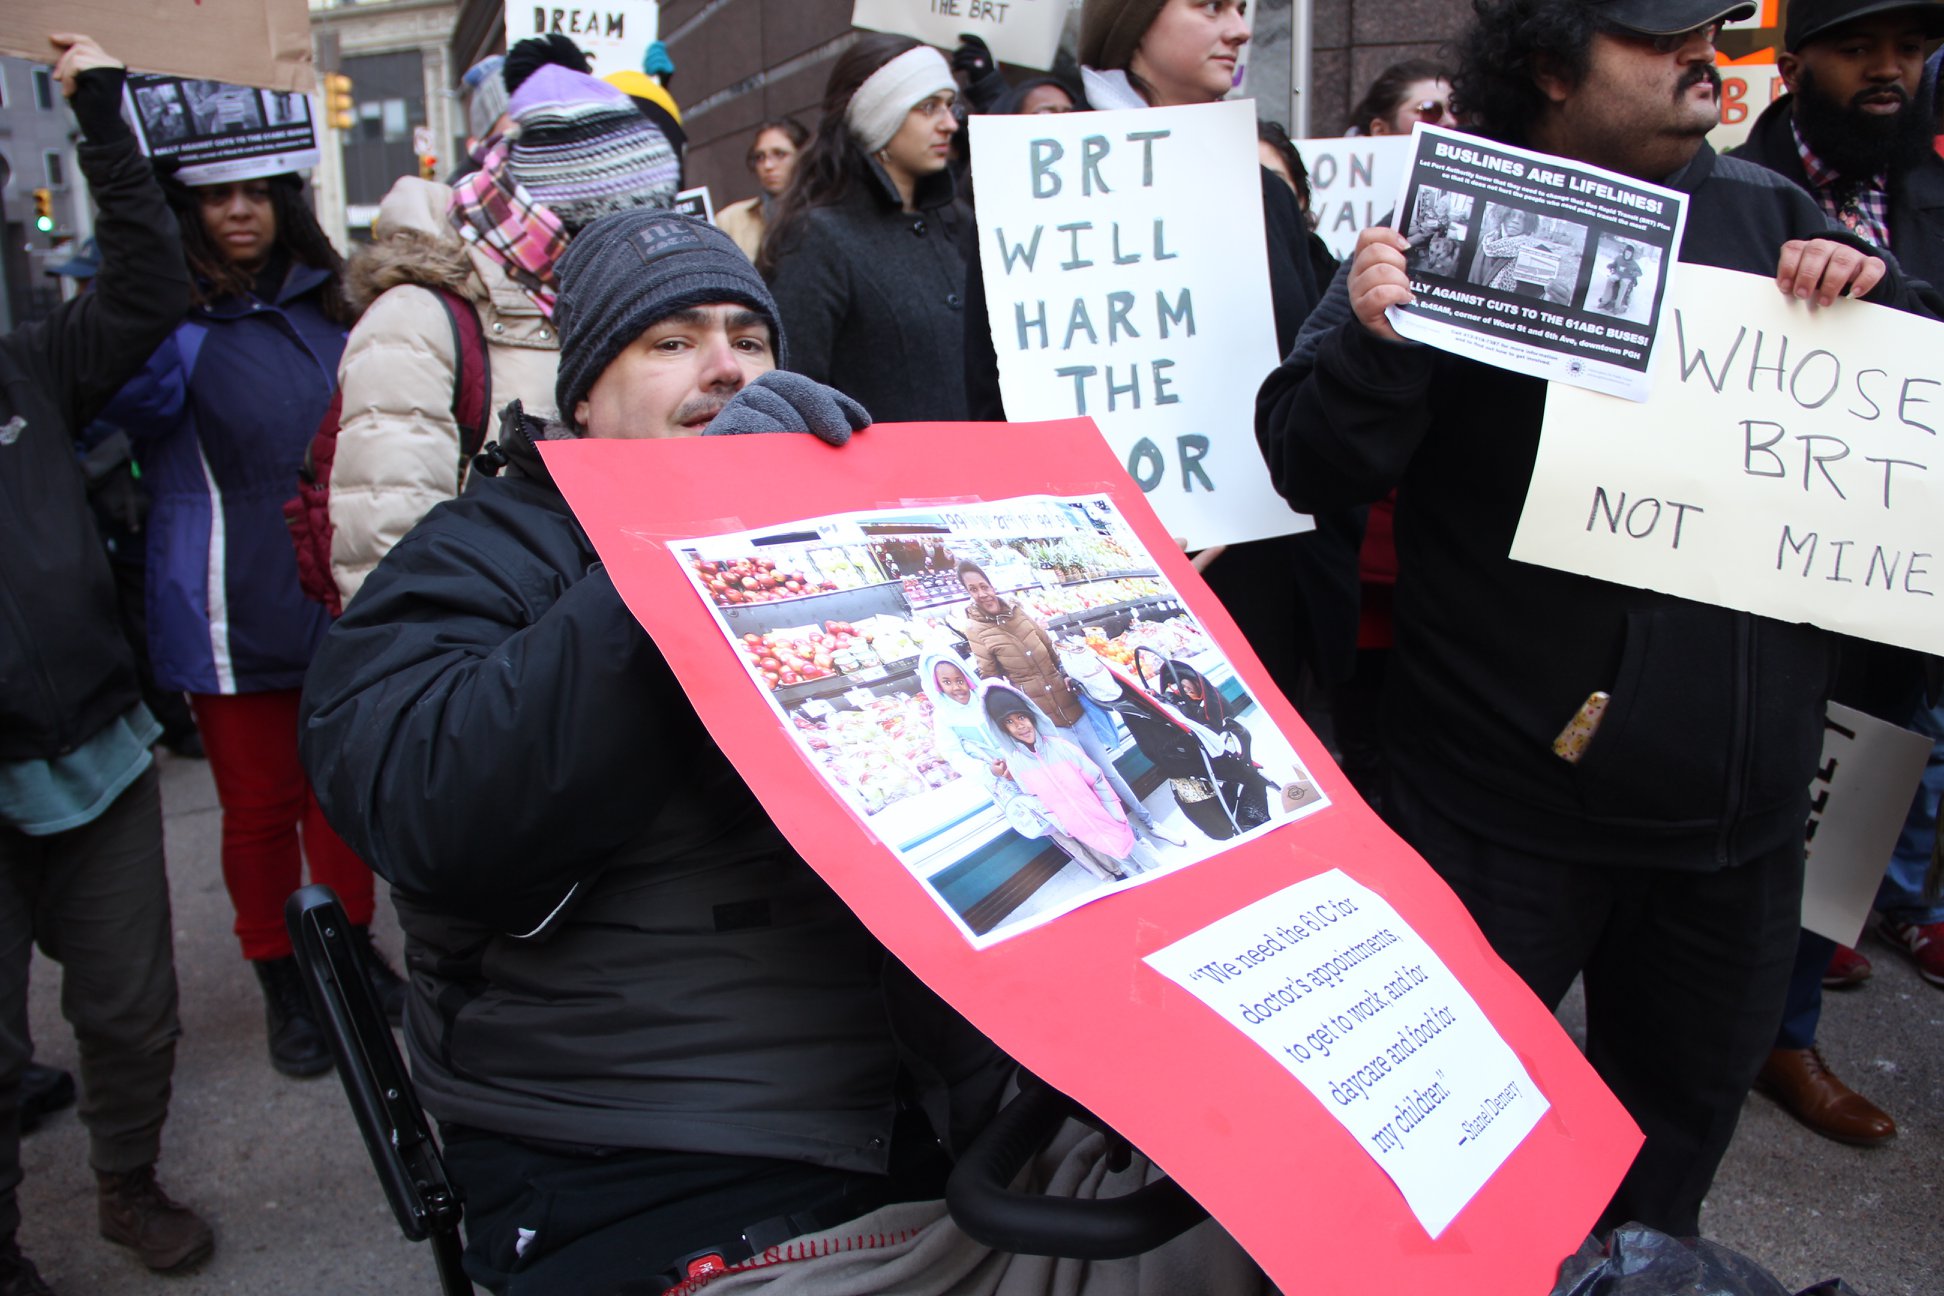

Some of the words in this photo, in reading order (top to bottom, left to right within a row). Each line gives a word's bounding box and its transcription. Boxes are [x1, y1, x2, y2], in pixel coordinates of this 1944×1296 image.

[534, 7, 624, 38] DREAM
[969, 1, 1010, 23] BRT
[1030, 130, 1171, 199] BRT
[1431, 162, 1445, 170] Port
[1446, 166, 1474, 179] Authority
[1476, 174, 1492, 182] know
[1493, 178, 1506, 186] that
[1507, 182, 1521, 190] they
[1546, 193, 1570, 202] change
[1570, 198, 1586, 206] their
[1586, 202, 1598, 210] Bus
[1598, 205, 1616, 214] Rapid
[1618, 210, 1639, 221] Transit
[1657, 222, 1670, 231] Plan
[1435, 142, 1524, 177] BUSLINES
[1526, 168, 1566, 188] ARE
[1569, 176, 1664, 214] LIFELINES!
[1450, 174, 1464, 182] that
[1470, 180, 1486, 188] does
[1498, 186, 1512, 194] hurt
[1524, 194, 1545, 203] people
[1560, 202, 1577, 210] need
[1577, 208, 1596, 216] public
[1597, 212, 1618, 222] transit
[1618, 218, 1628, 226] the
[994, 216, 1178, 276] WILL
[1014, 288, 1196, 350] HARM
[1409, 281, 1431, 294] LLY
[1432, 286, 1485, 306] AGAINST
[1486, 300, 1518, 315] CUTS
[1521, 308, 1538, 320] TO
[1540, 312, 1564, 326] THE
[1565, 319, 1604, 336] 61ABC
[1606, 328, 1649, 346] BUSES!
[1420, 301, 1452, 316] 8:45AM,
[1454, 310, 1482, 322] corner
[1482, 315, 1492, 324] of
[1493, 318, 1516, 330] Wood
[1516, 324, 1527, 333] St
[1528, 328, 1544, 336] and
[1544, 331, 1558, 340] 6th
[1559, 335, 1578, 346] Ave,
[1579, 340, 1622, 355] downtown
[1622, 349, 1641, 360] PGH
[1054, 358, 1181, 416] THE
[1674, 308, 1942, 436] WHOSE
[1126, 433, 1215, 493] OR
[1738, 420, 1928, 510] BRT
[1586, 486, 1704, 550] NOT
[1776, 525, 1934, 596] MINE
[1189, 962, 1242, 984] “We
[1235, 934, 1286, 968] need
[1276, 926, 1310, 950] the
[1299, 904, 1338, 932] 61C
[1328, 898, 1358, 923] for
[1240, 976, 1312, 1024] doctor's
[1306, 927, 1404, 988] appointments,
[1283, 1042, 1311, 1064] to
[1306, 1022, 1340, 1057] get
[1328, 1012, 1354, 1034] to
[1347, 990, 1394, 1025] work,
[1384, 970, 1414, 1001] and
[1402, 963, 1428, 990] for
[1328, 1053, 1392, 1106] daycare
[1386, 1031, 1416, 1065] and
[1405, 1007, 1442, 1047] food
[1438, 1004, 1456, 1028] for
[1484, 1080, 1523, 1116] Demery
[1371, 1122, 1404, 1154] my
